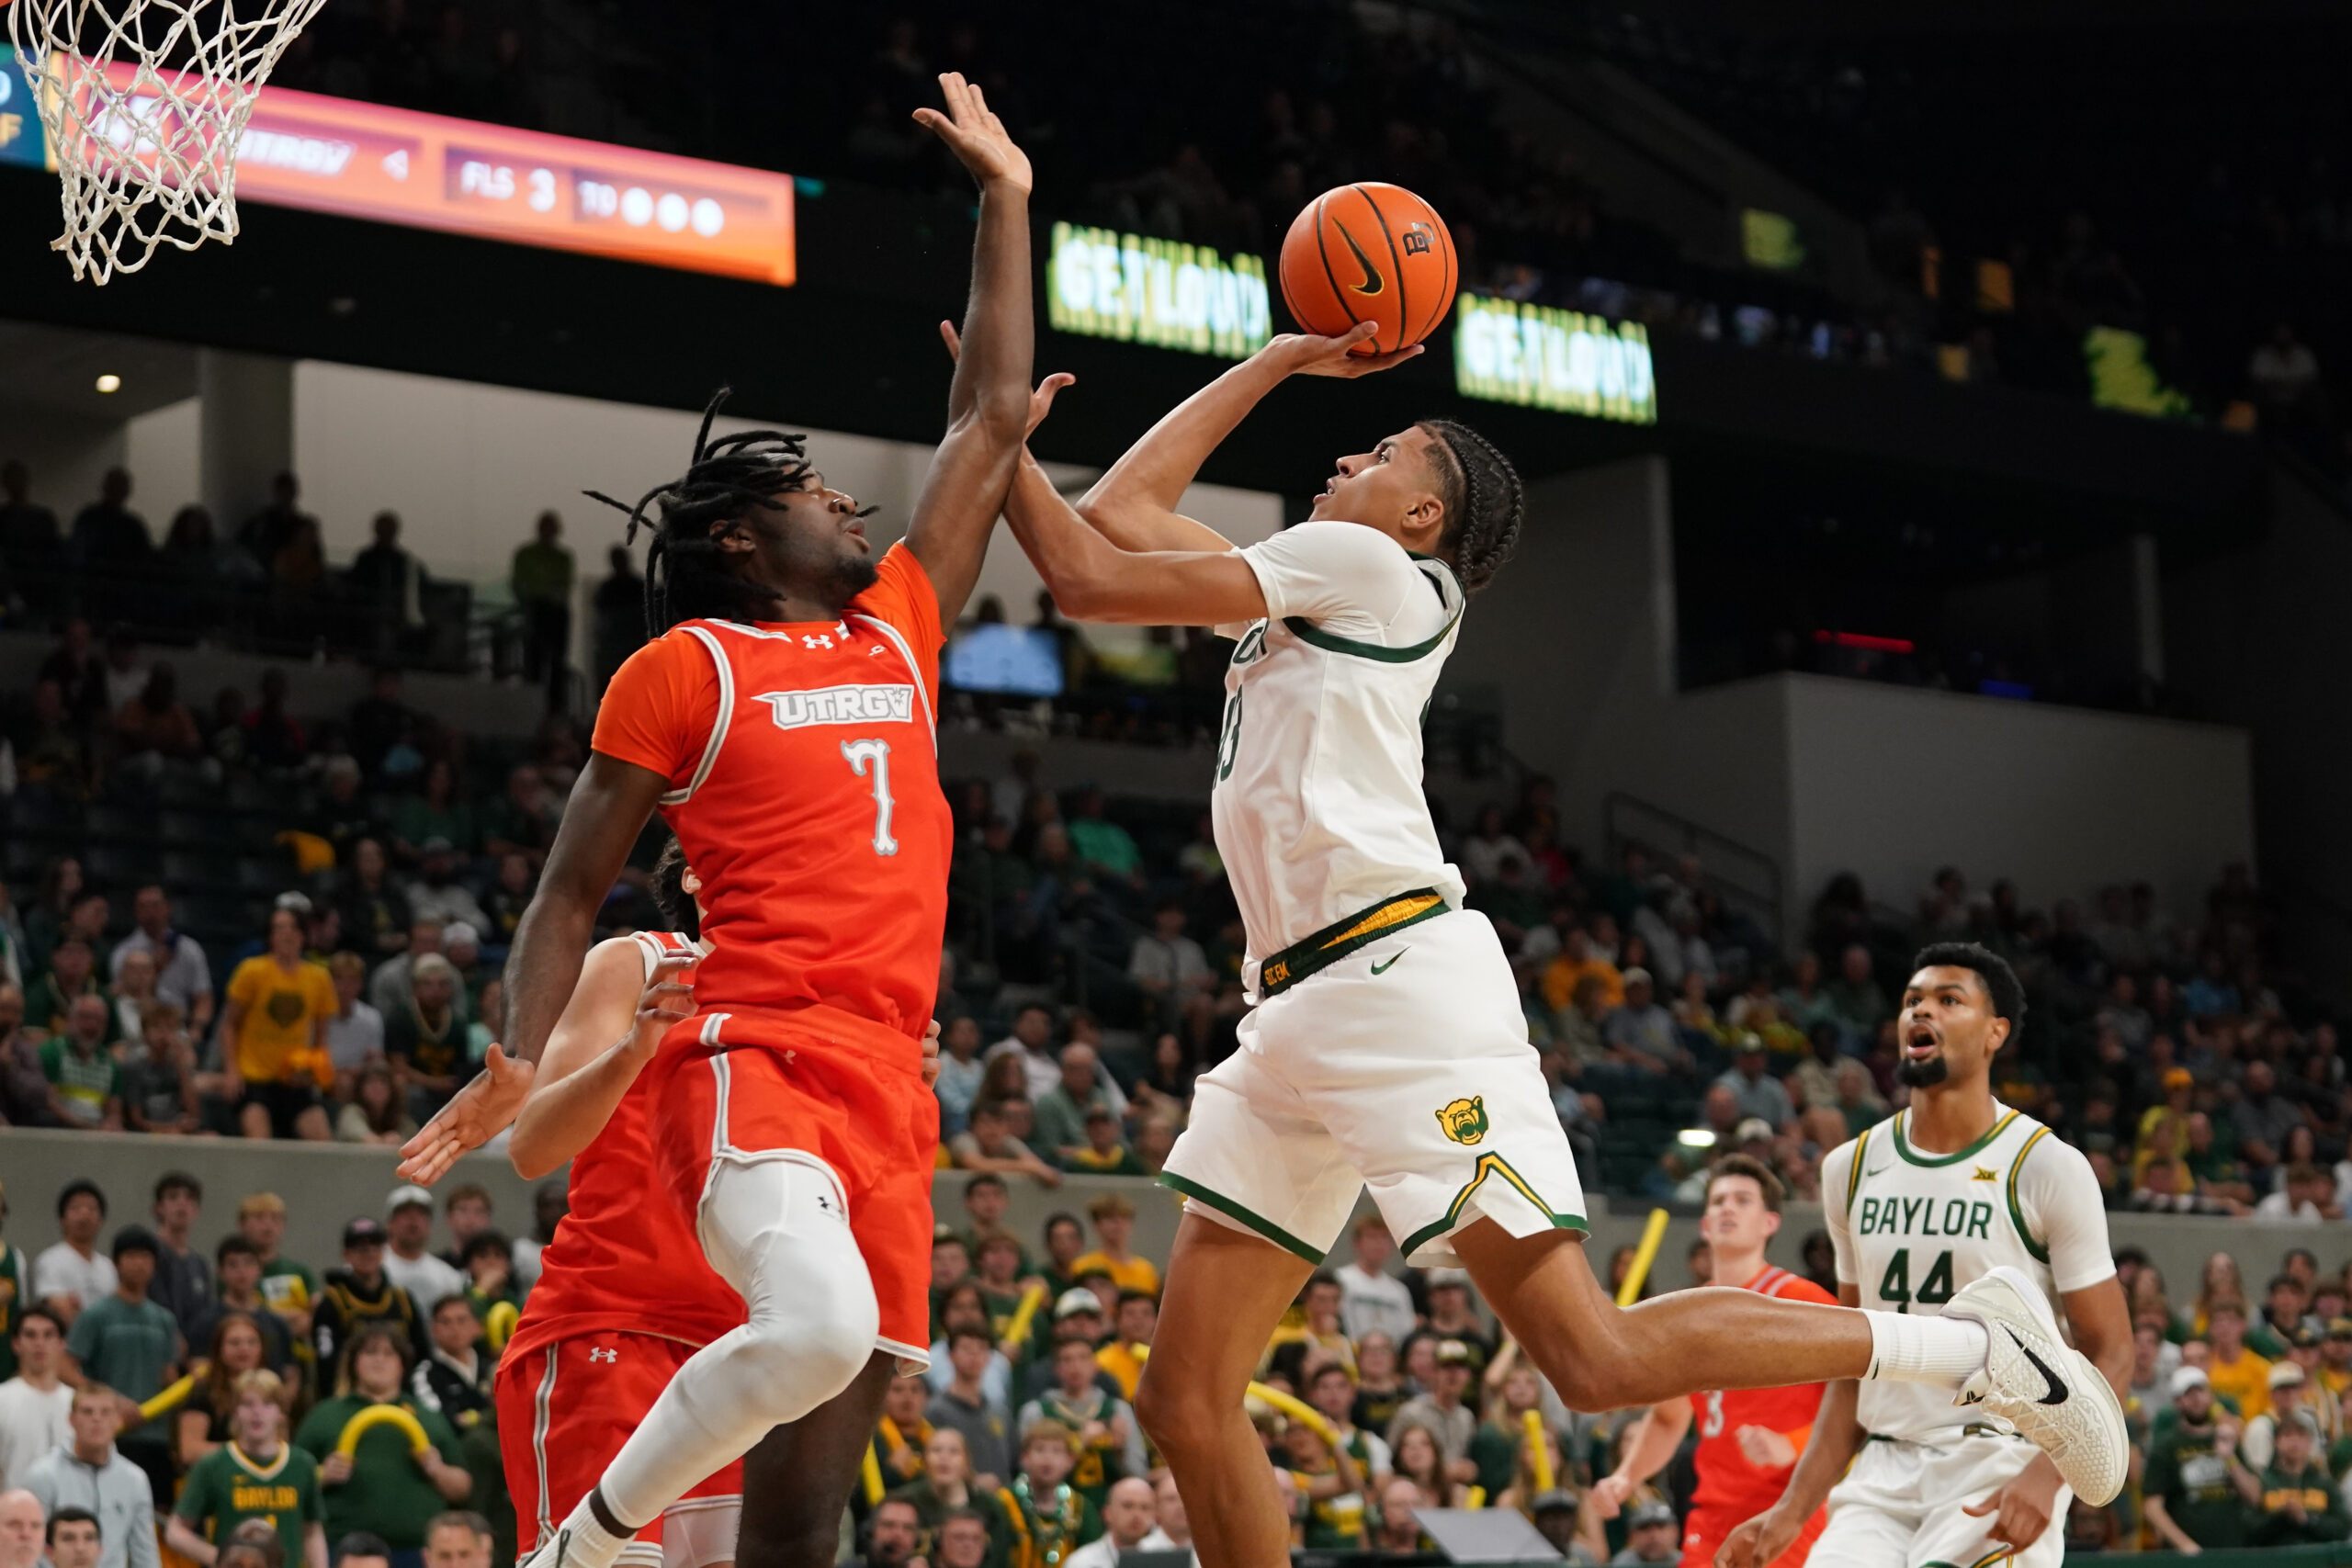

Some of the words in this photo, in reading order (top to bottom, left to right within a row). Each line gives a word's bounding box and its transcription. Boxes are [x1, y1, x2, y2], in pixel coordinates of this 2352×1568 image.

[460, 160, 515, 200] FLS
[527, 167, 556, 213] 3
[751, 684, 914, 730] UTRGV
[840, 738, 899, 856] 7
[1860, 1197, 1993, 1239] BAYLOR
[1879, 1247, 1955, 1314] 44
